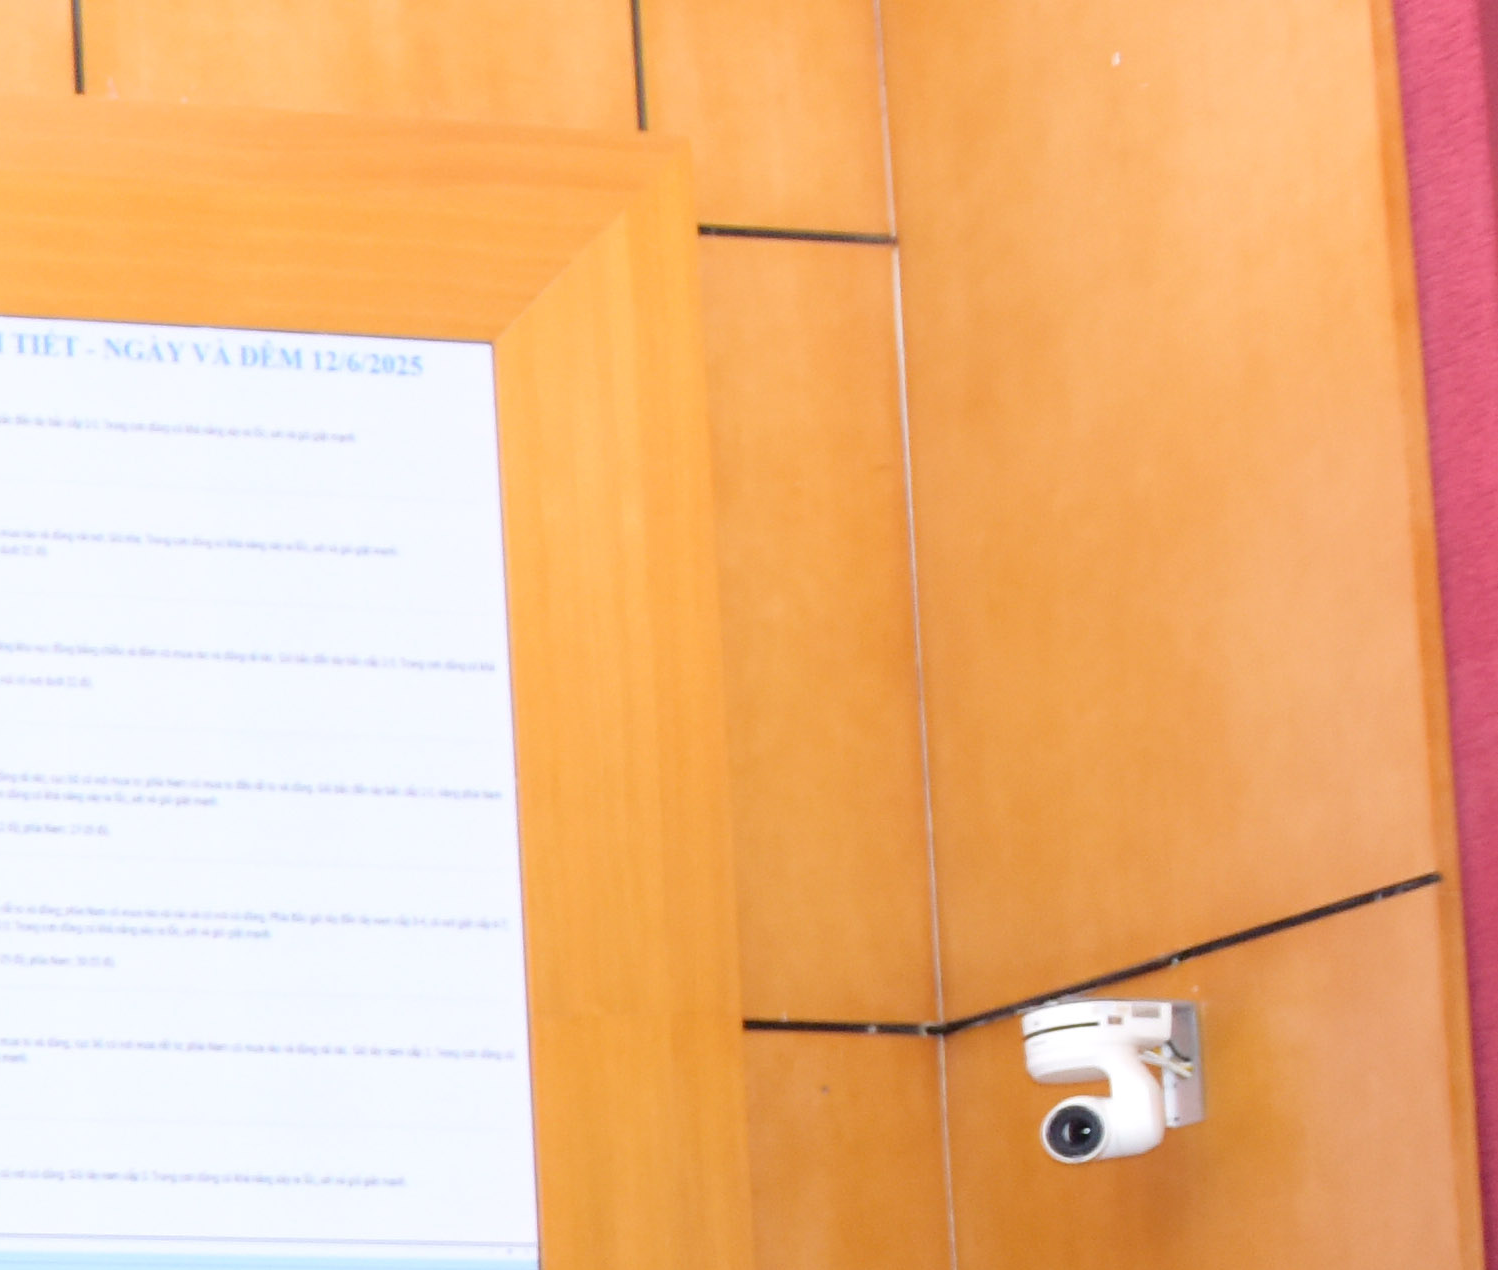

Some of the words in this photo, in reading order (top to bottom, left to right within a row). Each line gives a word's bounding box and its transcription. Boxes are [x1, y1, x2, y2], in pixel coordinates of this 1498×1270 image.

[14, 332, 78, 357] TIẾT
[105, 338, 183, 363] NGÀY
[193, 343, 232, 366] VÀ
[241, 340, 303, 370] ĐÊM
[314, 350, 424, 376] 12/6/2025
